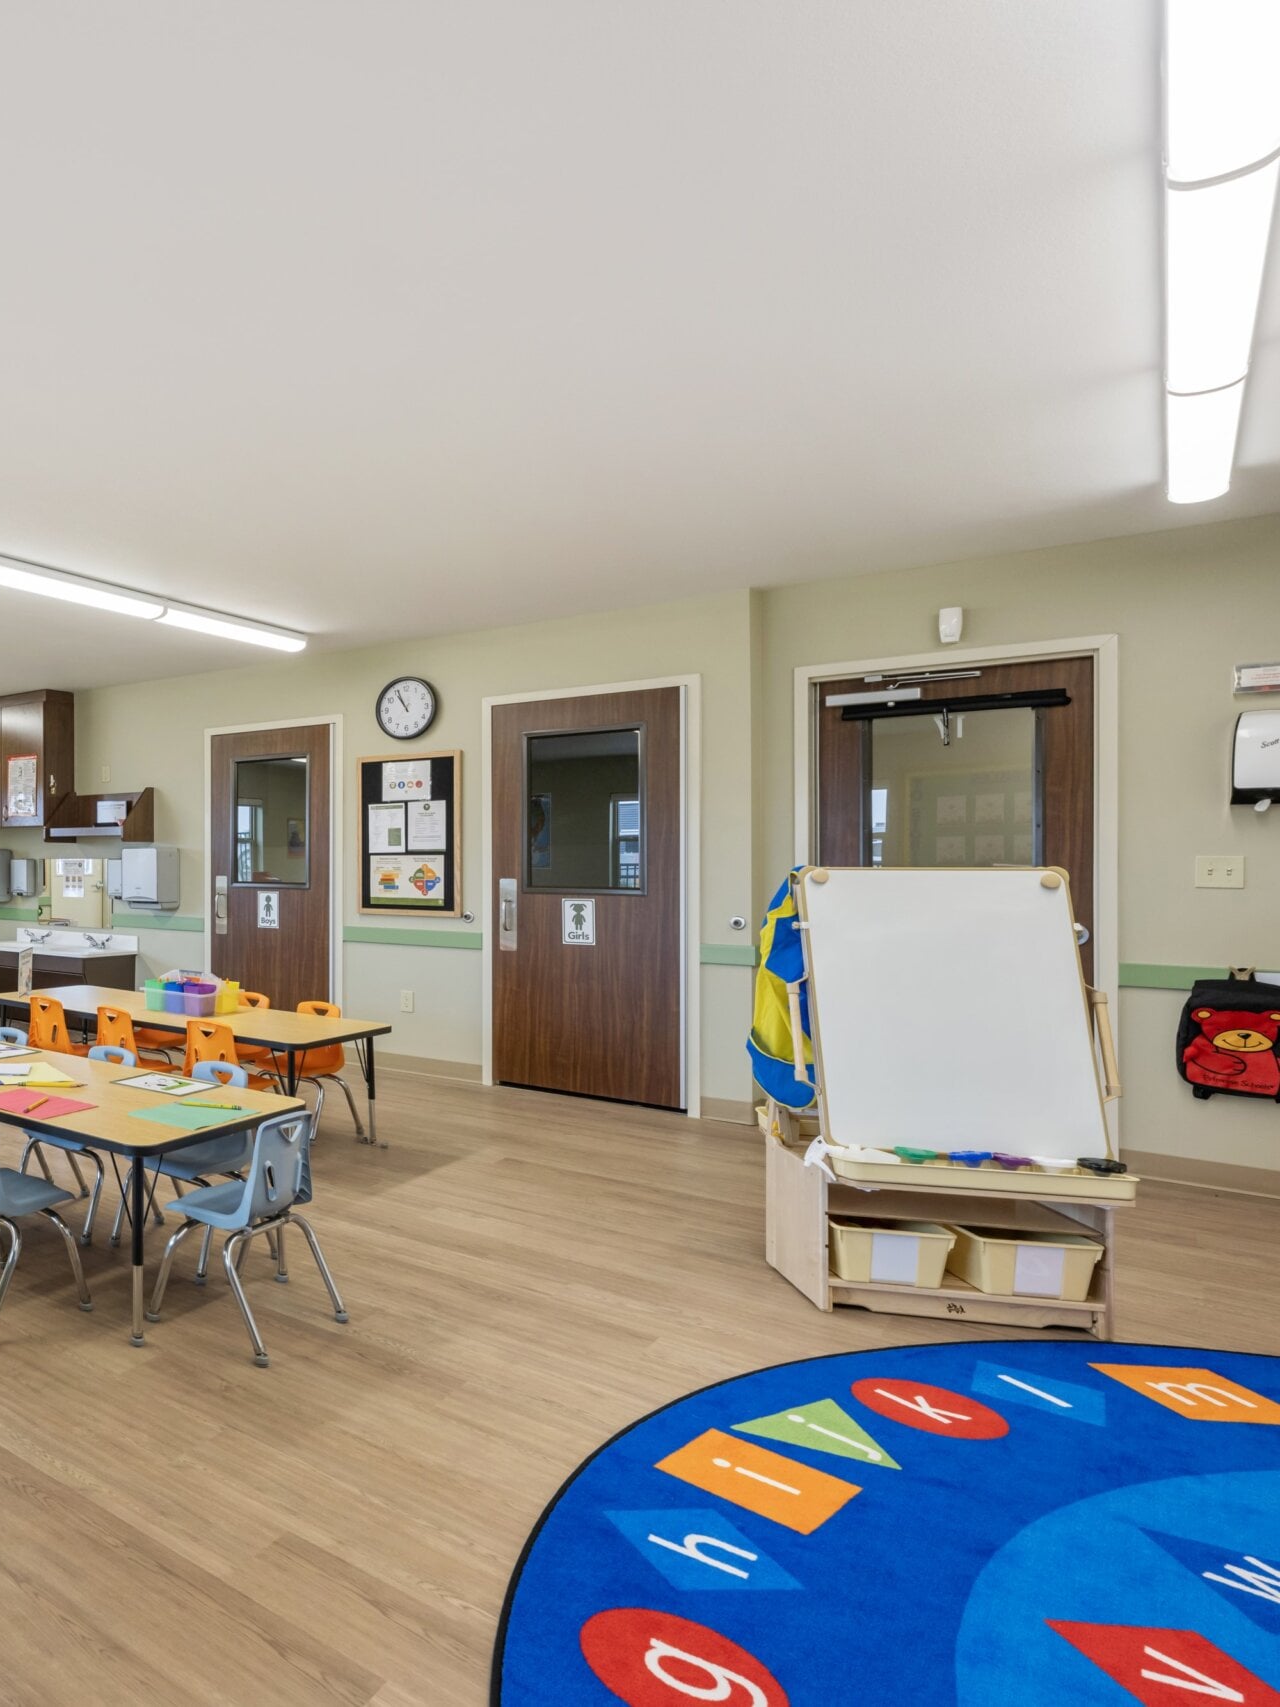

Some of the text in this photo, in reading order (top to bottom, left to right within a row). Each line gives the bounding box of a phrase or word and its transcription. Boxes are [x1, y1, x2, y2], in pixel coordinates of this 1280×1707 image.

[260, 916, 276, 926] Boys
[567, 931, 590, 940] Girls
[874, 1388, 972, 1424] k
[997, 1374, 1073, 1408] l
[1145, 1381, 1259, 1409] m
[786, 1414, 882, 1462] j
[712, 1457, 801, 1496] i
[648, 1533, 758, 1580] h
[644, 1637, 768, 1707] g
[1140, 1645, 1244, 1703] v
